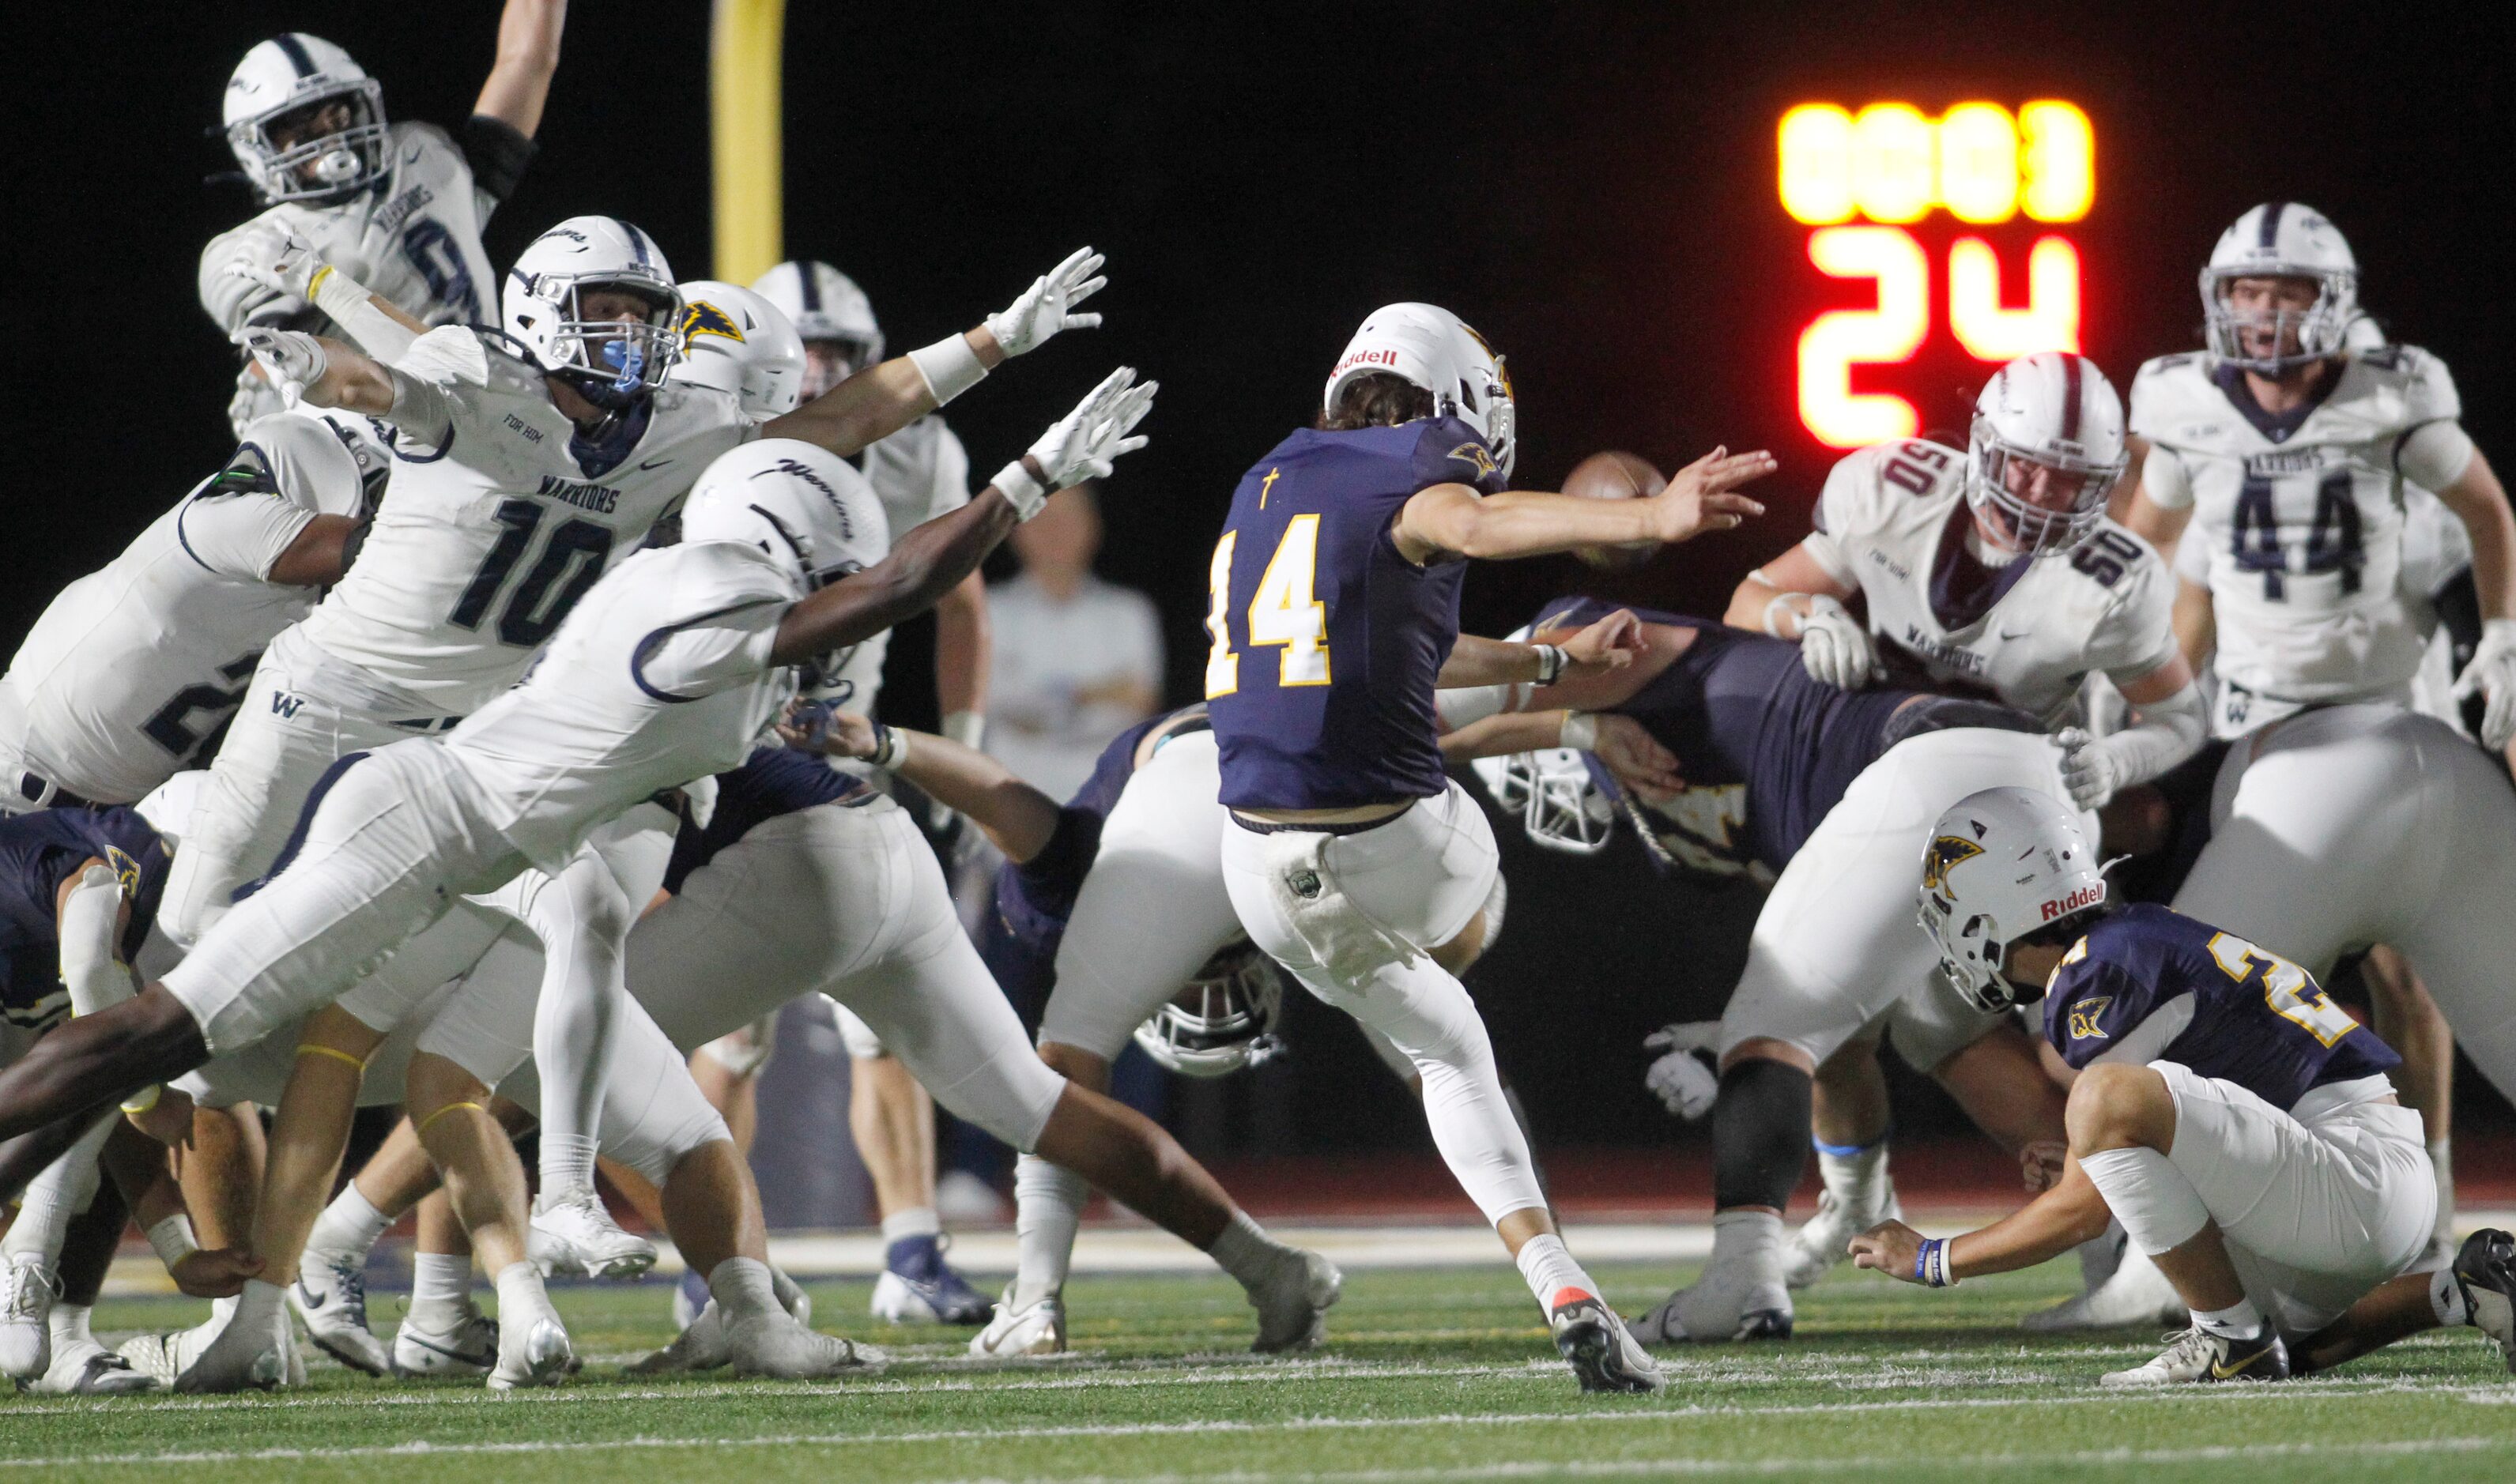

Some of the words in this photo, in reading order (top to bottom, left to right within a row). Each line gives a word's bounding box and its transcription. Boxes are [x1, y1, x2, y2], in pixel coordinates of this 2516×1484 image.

[1798, 225, 2080, 448] 24
[504, 413, 524, 432] FOR
[522, 426, 544, 444] HIM
[537, 474, 621, 514] WARRIORS
[1884, 443, 1949, 495] 50
[2069, 529, 2144, 588] 50
[2231, 468, 2367, 604] 44
[446, 493, 617, 650] 10
[1204, 514, 1332, 700] 14
[272, 690, 304, 719] W
[2040, 883, 2103, 921] Riddell
